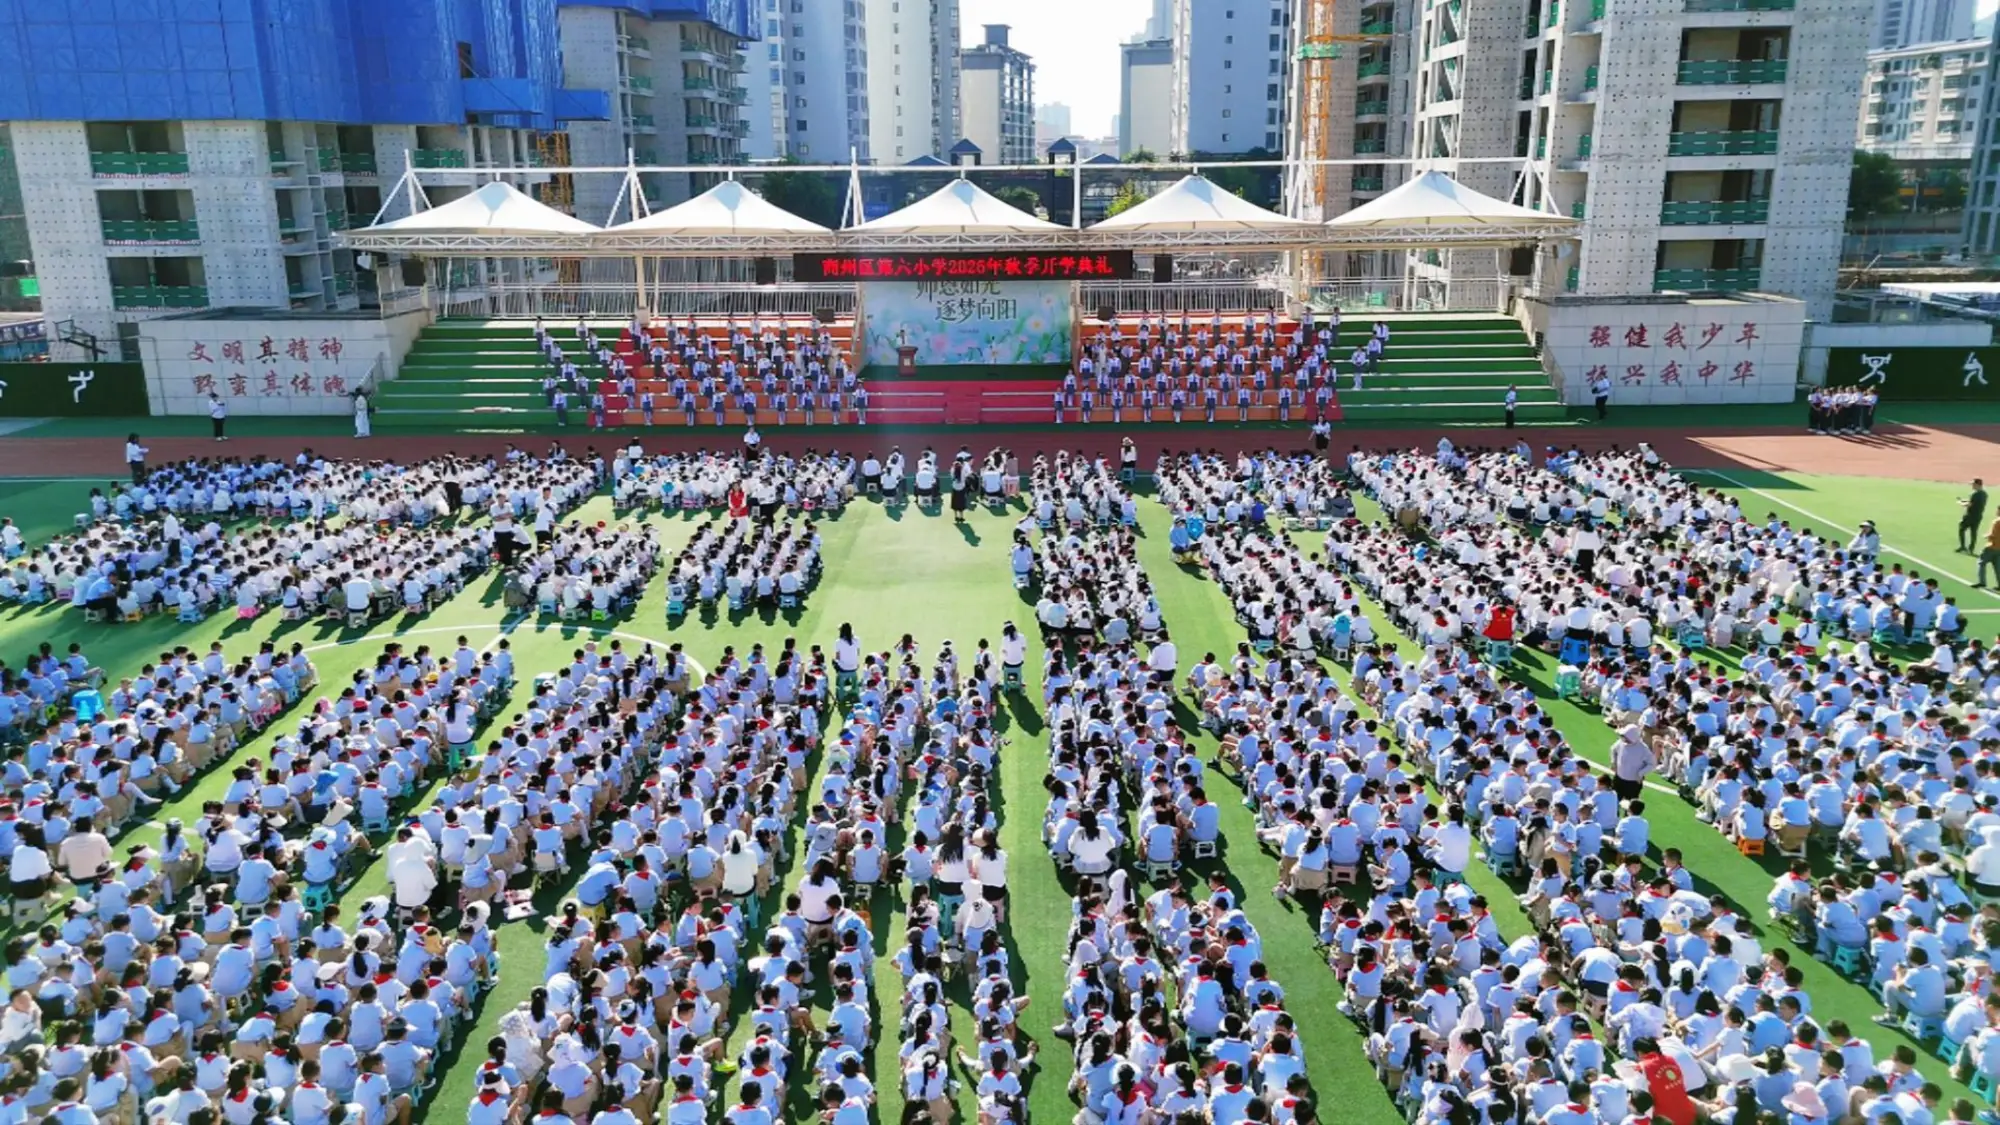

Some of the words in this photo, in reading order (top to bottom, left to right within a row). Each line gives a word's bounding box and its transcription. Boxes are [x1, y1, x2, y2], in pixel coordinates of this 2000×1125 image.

[934, 298, 1017, 324] 逐梦向阳
[1589, 321, 1760, 350] 强健我少年
[188, 335, 343, 365] 文明其精神
[193, 369, 351, 397] 野蛮其体魄
